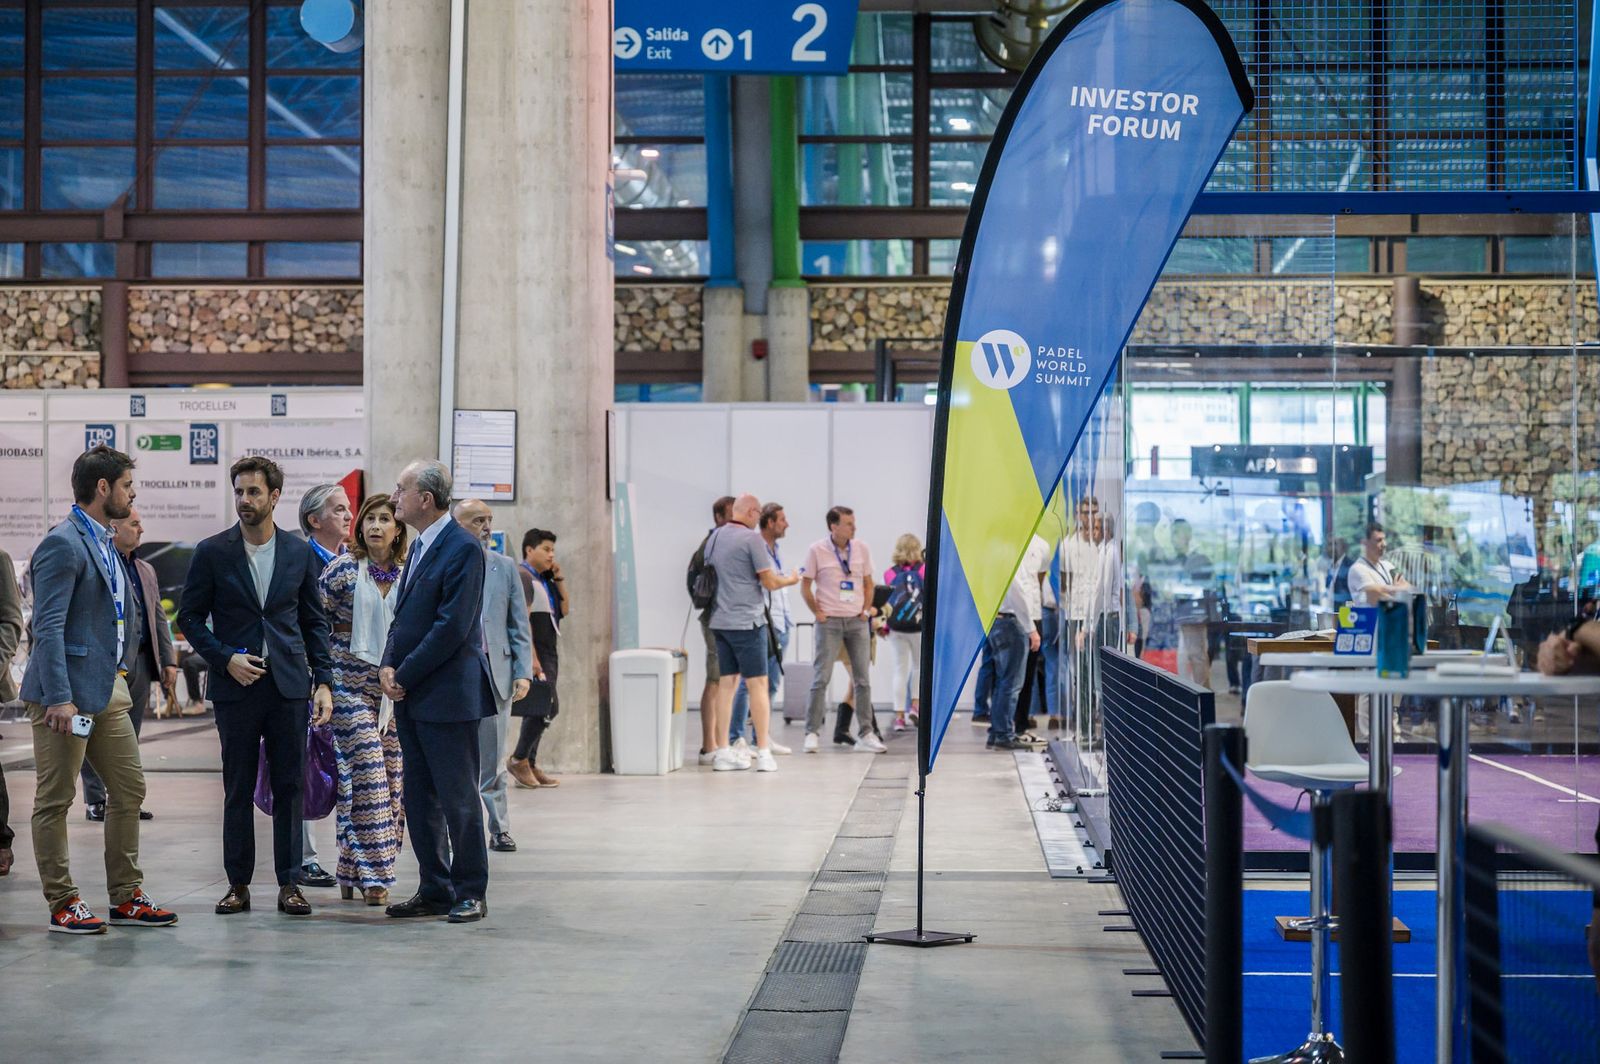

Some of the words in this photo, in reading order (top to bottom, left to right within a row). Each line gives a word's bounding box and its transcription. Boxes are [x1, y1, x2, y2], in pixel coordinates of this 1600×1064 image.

[646, 27, 689, 42] Salida
[792, 3, 828, 62] 2
[738, 29, 753, 61] 1
[647, 47, 672, 60] Exit
[1070, 86, 1199, 115] INVESTOR
[1088, 114, 1182, 141] FORUM
[1038, 346, 1084, 360] PADEL
[1036, 359, 1087, 373] WORLD
[1035, 373, 1092, 387] SUMMIT
[178, 400, 237, 411] TROCELLEN
[86, 428, 113, 440] TRO
[190, 428, 217, 440] TRO
[192, 439, 211, 449] CEL
[192, 447, 216, 459] LEN
[245, 448, 304, 457] TROCELLEN
[140, 480, 188, 489] TROCELLEN
